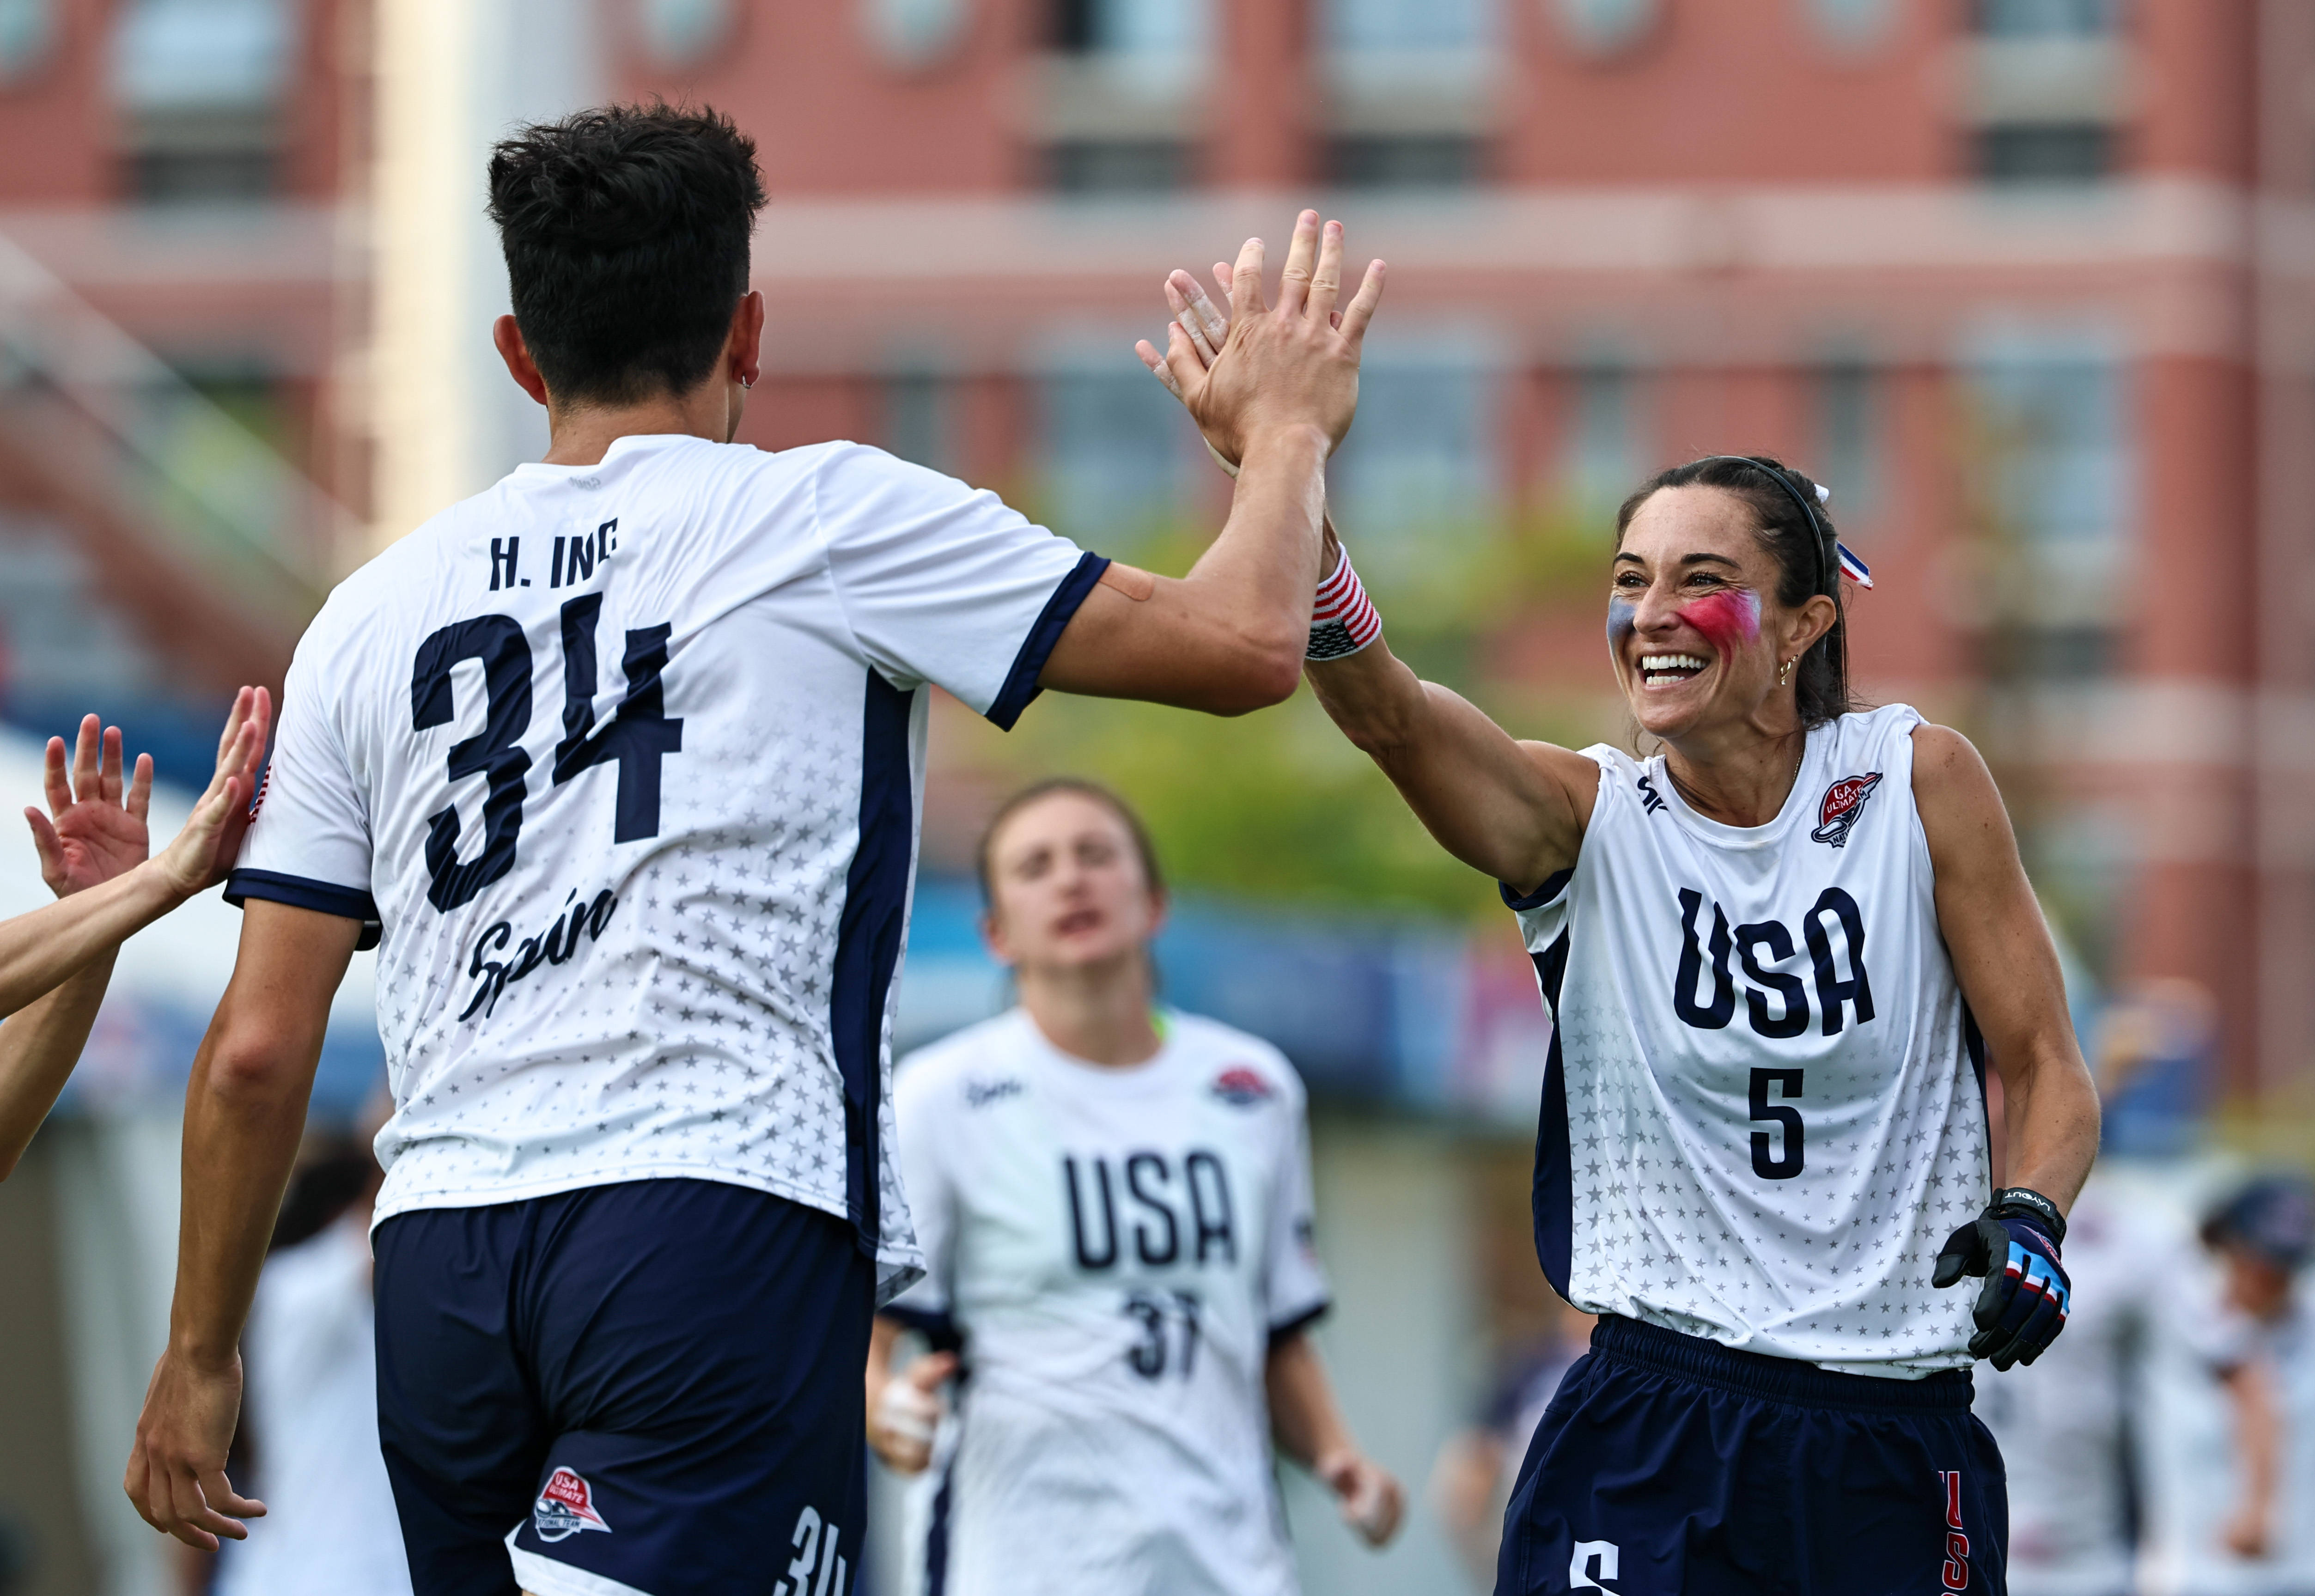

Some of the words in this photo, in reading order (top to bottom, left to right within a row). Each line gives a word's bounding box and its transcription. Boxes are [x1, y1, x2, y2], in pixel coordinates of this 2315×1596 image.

[489, 536, 530, 591] H.
[411, 591, 683, 914] 34
[1827, 784, 1862, 814] ULTMATE
[1674, 887, 1875, 1039] USA
[1749, 1067, 1804, 1180] 5
[1062, 1149, 1239, 1271] USA
[2004, 1191, 2051, 1212] LAYOUT
[548, 1484, 585, 1504] ULTIMATE
[555, 1473, 579, 1491] USA
